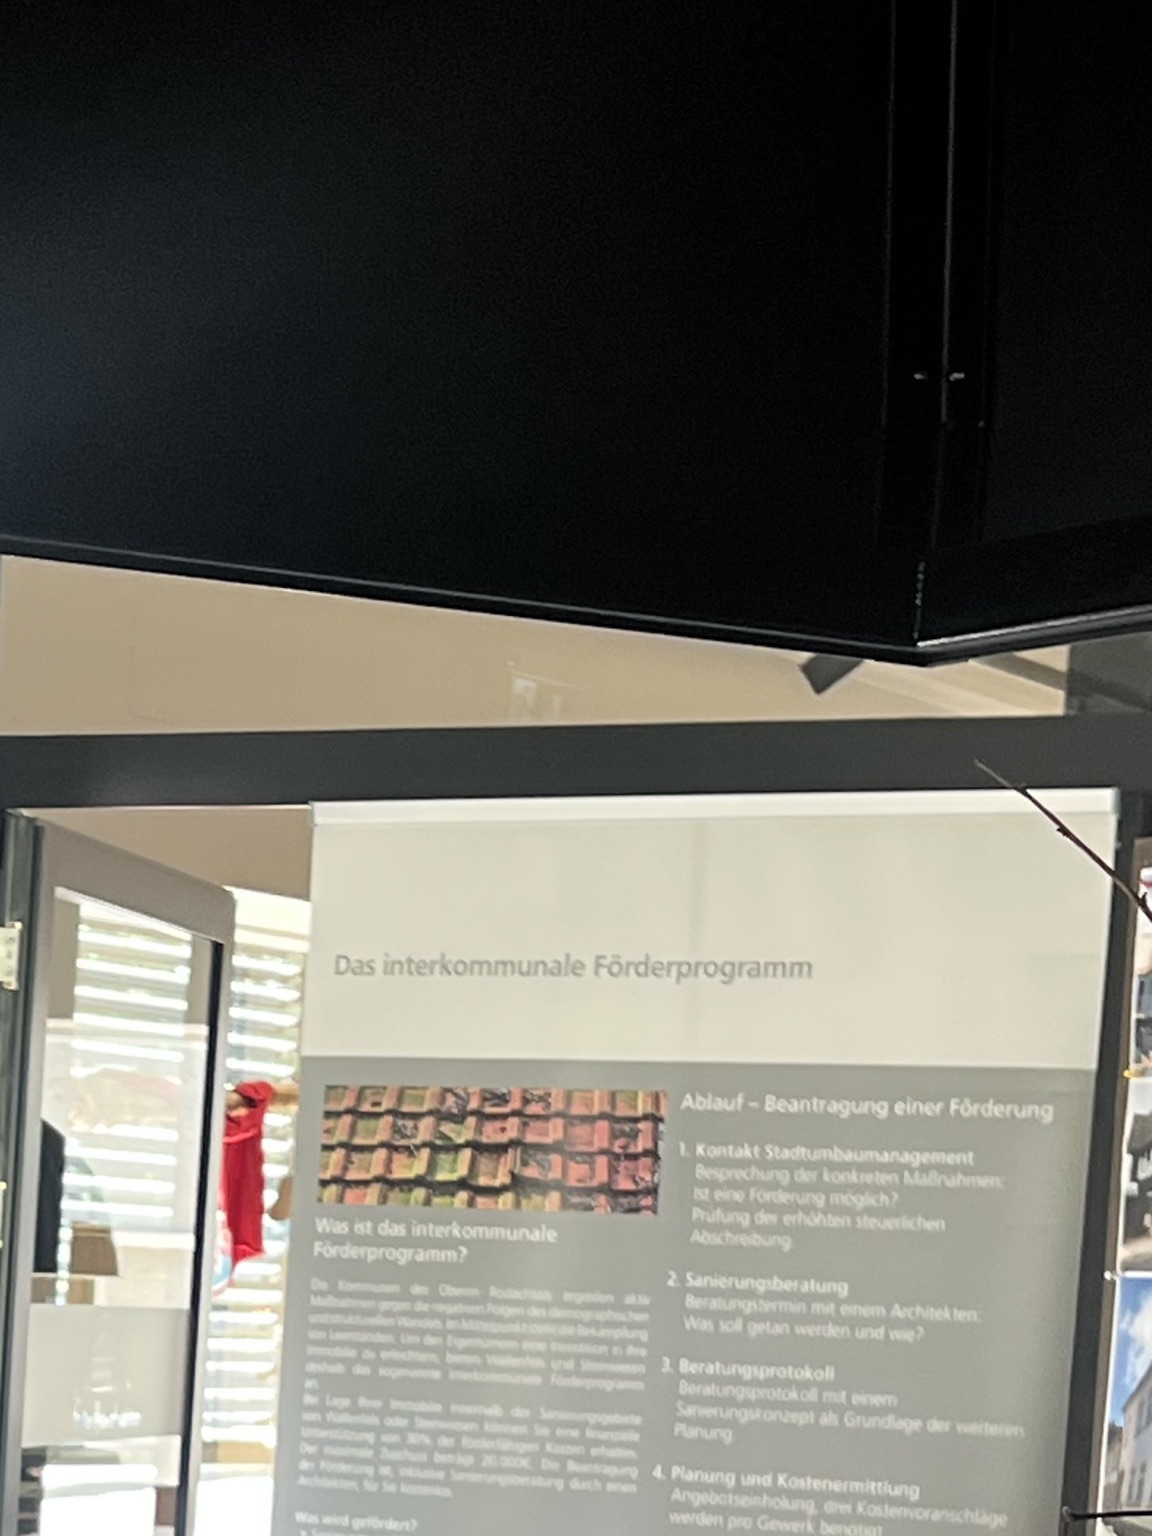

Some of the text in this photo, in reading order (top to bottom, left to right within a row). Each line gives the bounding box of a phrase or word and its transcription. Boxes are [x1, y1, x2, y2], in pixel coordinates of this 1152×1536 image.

[333, 952, 813, 984] Das interkommunale Förderprogramm
[680, 1092, 744, 1112] Ablauf
[764, 1095, 889, 1120] Beantragung
[894, 1101, 943, 1116] einer
[950, 1098, 1054, 1124] Förderung
[696, 1143, 759, 1159] Kontakt
[764, 1144, 974, 1167] Stadtumbaumanagement
[794, 1166, 818, 1182] der
[714, 1189, 744, 1202] eine
[750, 1188, 825, 1207] Förderung
[315, 1217, 557, 1243] Was ist das interkommunale
[692, 1207, 749, 1228] Prüfung
[755, 1209, 778, 1225] der
[855, 1212, 946, 1232] steuerlichen
[313, 1241, 468, 1265] Förderprogramm?
[667, 1271, 848, 1298] 2. Sanierungsberatung
[686, 1293, 806, 1315] Beratungstermin
[811, 1300, 836, 1316] mit
[840, 1302, 886, 1318] einem
[684, 1315, 925, 1343] Was soll getan werden und wie?
[679, 1358, 835, 1382] Beratungsprotokoll
[679, 1379, 897, 1408] Beratungsprotokoll mit einem
[844, 1410, 922, 1434] Grundlage
[927, 1417, 951, 1433] der
[652, 1464, 666, 1481] 4.
[671, 1465, 736, 1489] Planung
[740, 1470, 772, 1488] und
[777, 1472, 920, 1501] Kostenermittlung
[295, 1512, 319, 1526] Was
[322, 1513, 349, 1528] wird
[670, 1510, 723, 1528] werden
[727, 1516, 752, 1532] pro
[757, 1516, 815, 1534] Gewerk
[857, 1501, 1008, 1529] Kostenvoranschläge
